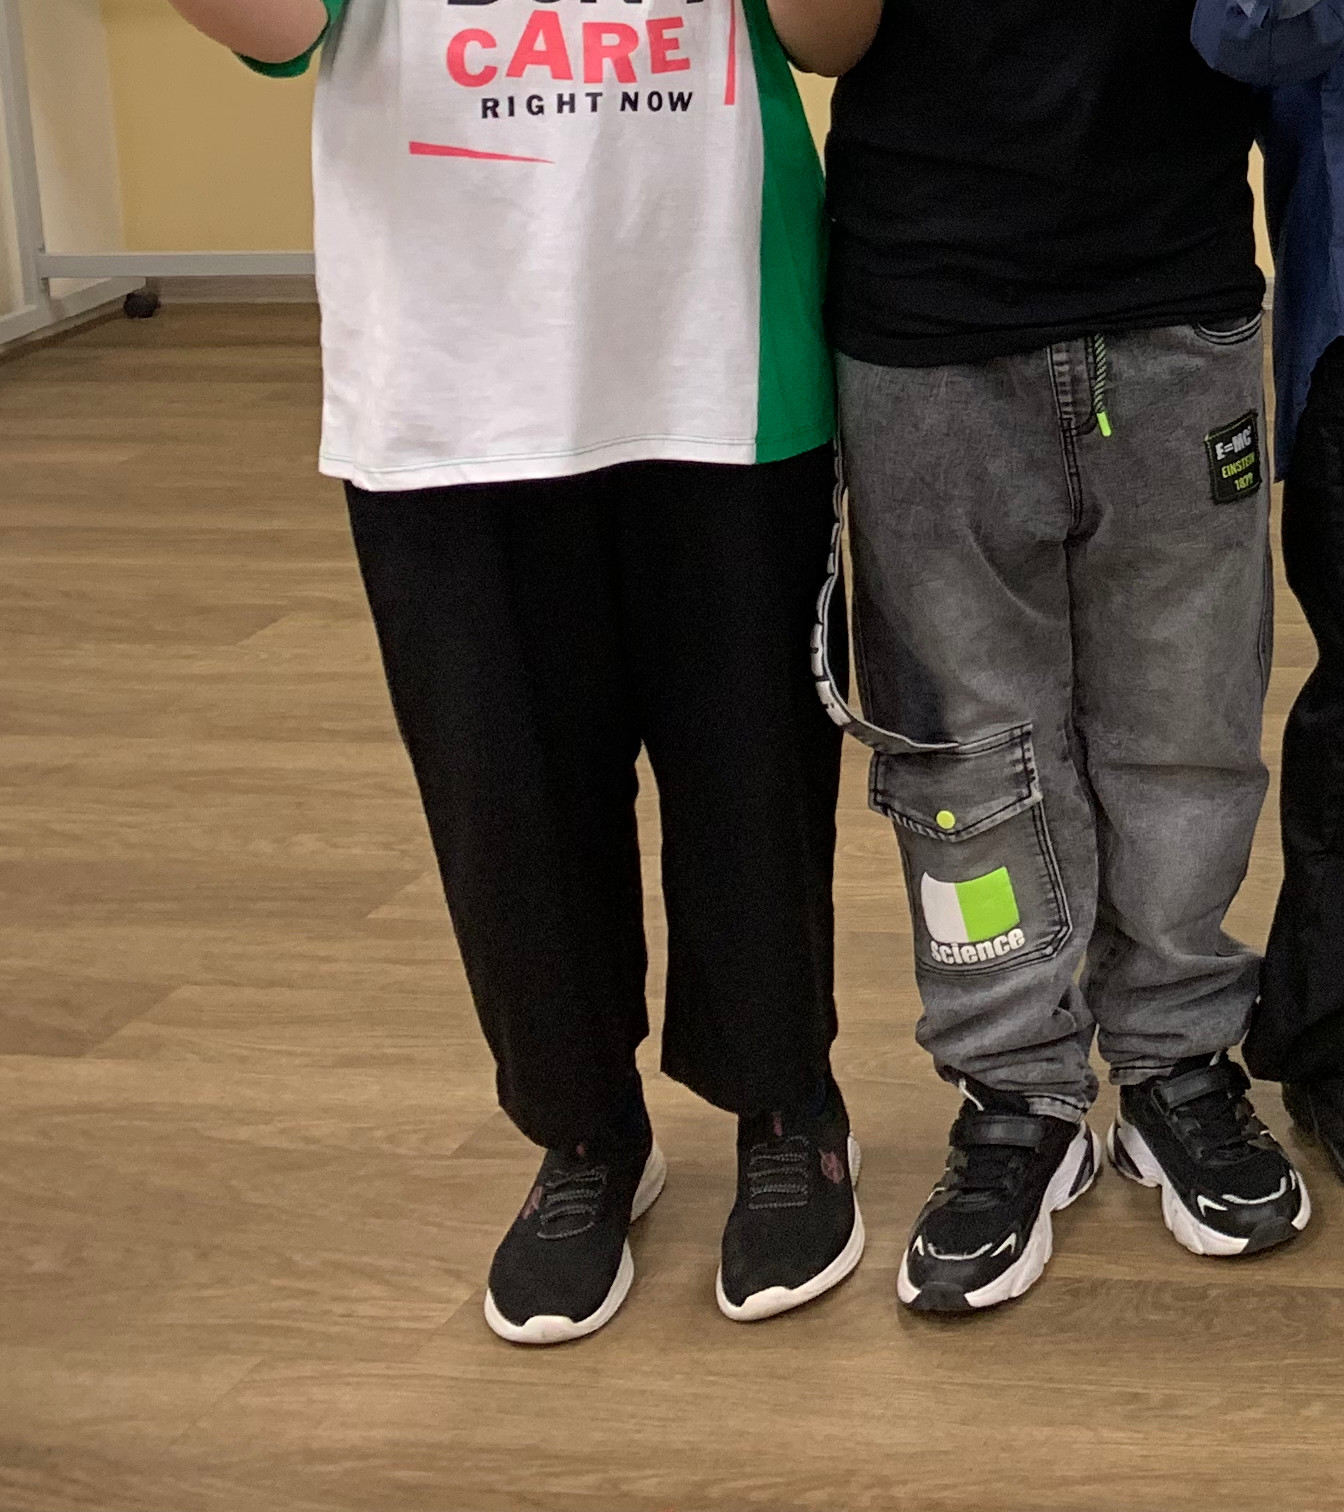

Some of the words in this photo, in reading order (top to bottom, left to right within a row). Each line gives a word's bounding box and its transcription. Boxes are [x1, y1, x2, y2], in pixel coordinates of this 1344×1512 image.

[481, 91, 604, 120] RIGHT
[620, 91, 694, 113] NOW
[930, 928, 1026, 965] science
